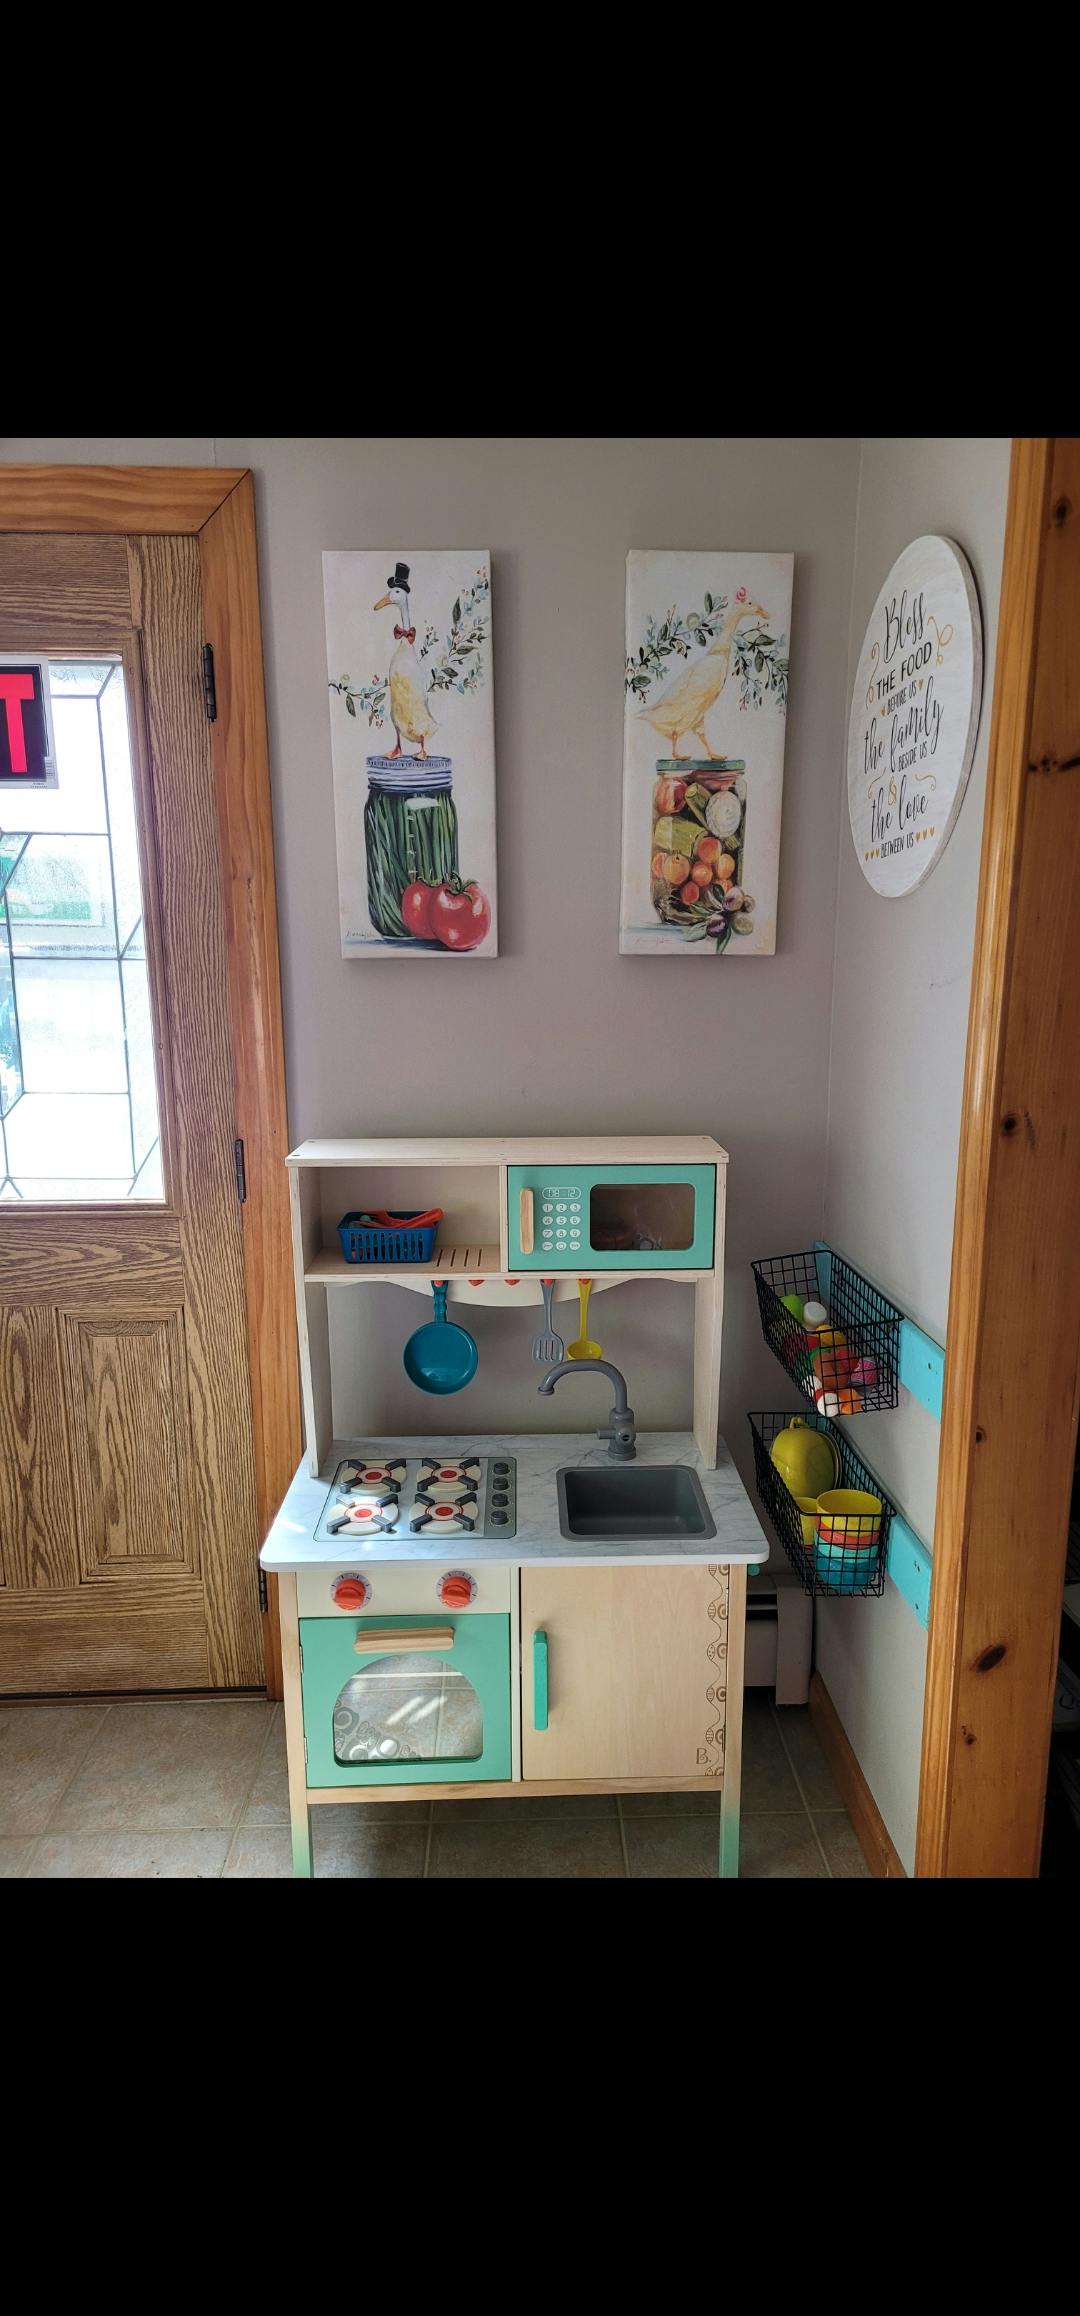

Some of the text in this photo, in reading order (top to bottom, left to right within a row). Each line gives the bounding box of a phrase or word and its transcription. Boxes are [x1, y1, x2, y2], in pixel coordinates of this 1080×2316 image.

[884, 590, 926, 664] Bless
[877, 642, 932, 699] THE FOOD
[887, 680, 917, 716] BEFORE US
[0, 674, 35, 772] T
[864, 676, 944, 774] the family
[899, 740, 928, 772] BESIDE US
[871, 774, 928, 843] the love
[888, 775, 897, 805] &
[881, 832, 914, 859] BETWEEN US
